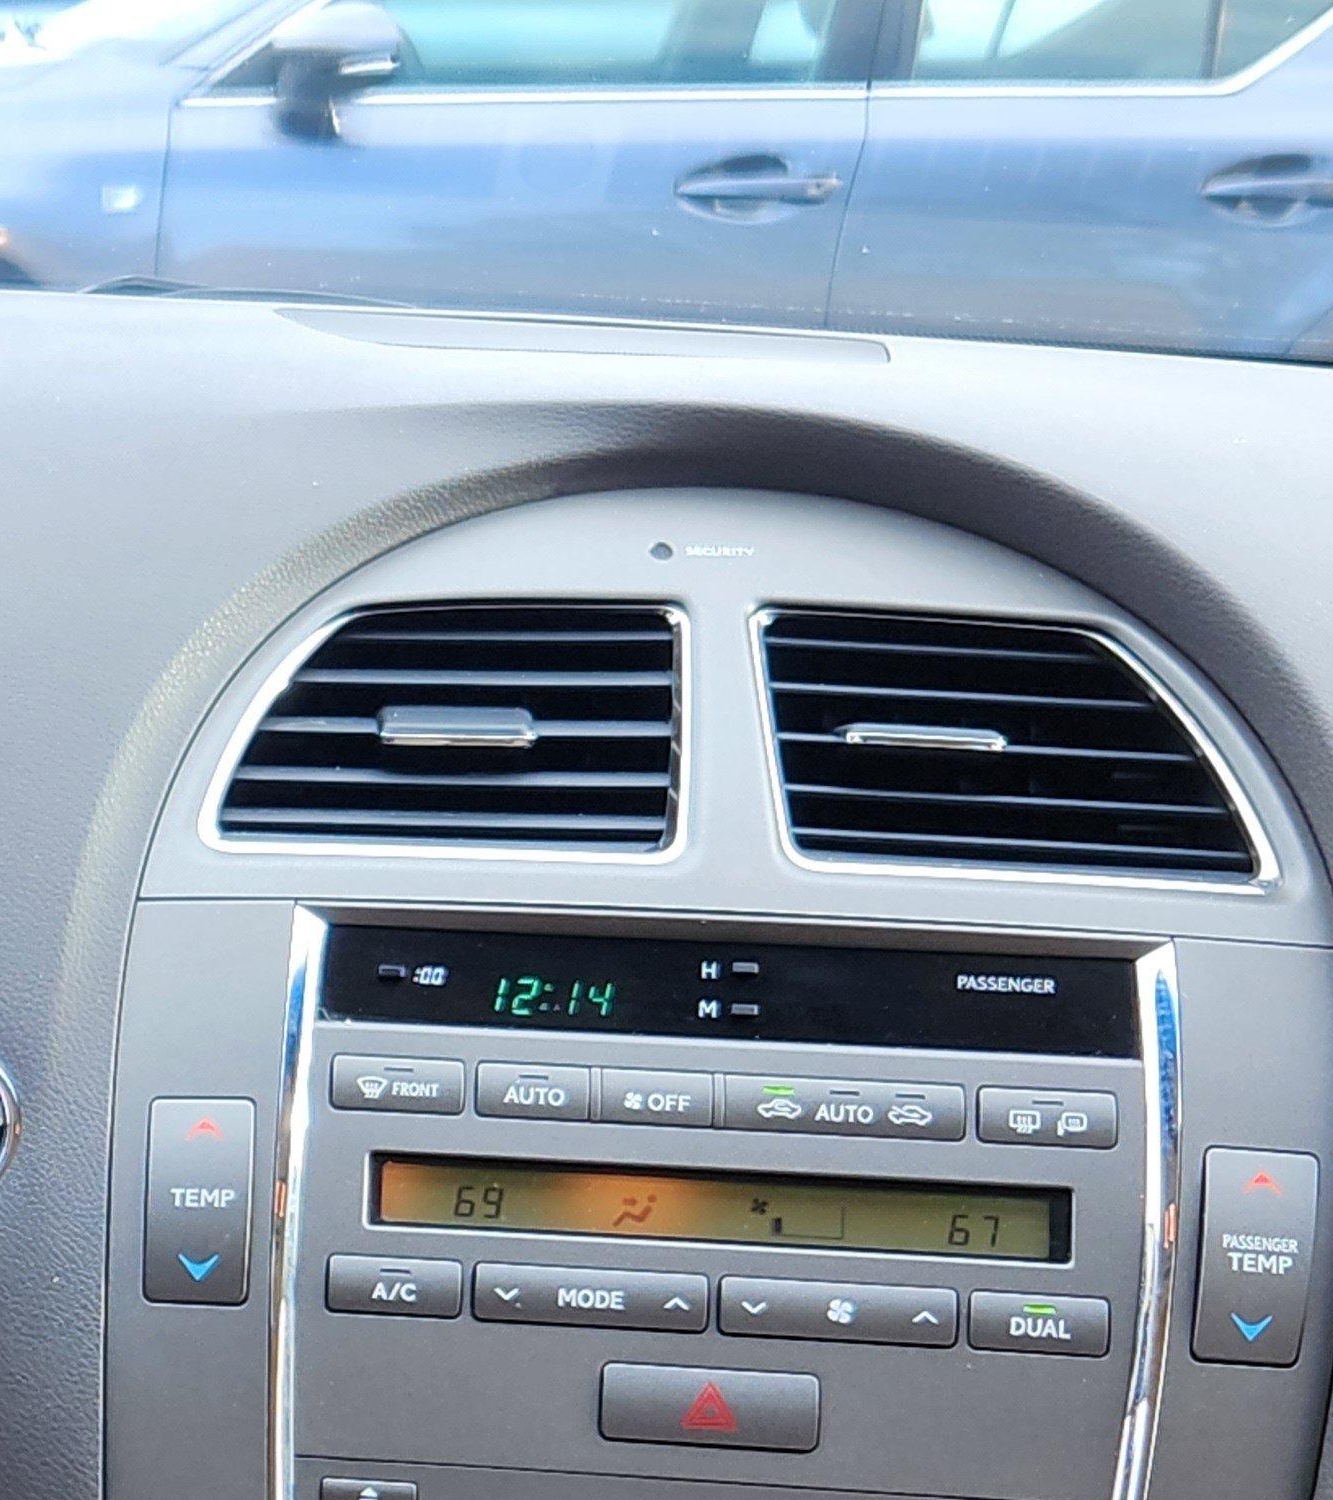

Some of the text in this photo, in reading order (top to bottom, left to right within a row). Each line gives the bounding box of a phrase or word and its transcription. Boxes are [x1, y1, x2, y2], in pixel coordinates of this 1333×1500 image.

[700, 961, 719, 981] H
[956, 974, 1057, 995] PASSENGER
[493, 976, 617, 1018] 12:14
[698, 999, 719, 1020] M
[391, 1080, 441, 1099] FRONT
[502, 1086, 566, 1108] AUTO
[646, 1092, 692, 1114] OFF
[814, 1104, 875, 1126] AUTO
[169, 1188, 236, 1209] TEMP
[452, 1185, 505, 1219] 69
[947, 1213, 1001, 1249] 67
[1221, 1233, 1300, 1254] PASSENGER
[1226, 1252, 1294, 1275] TEMP
[370, 1282, 418, 1303] A/C
[556, 1287, 626, 1312] MODE
[1008, 1316, 1073, 1341] DUAL
